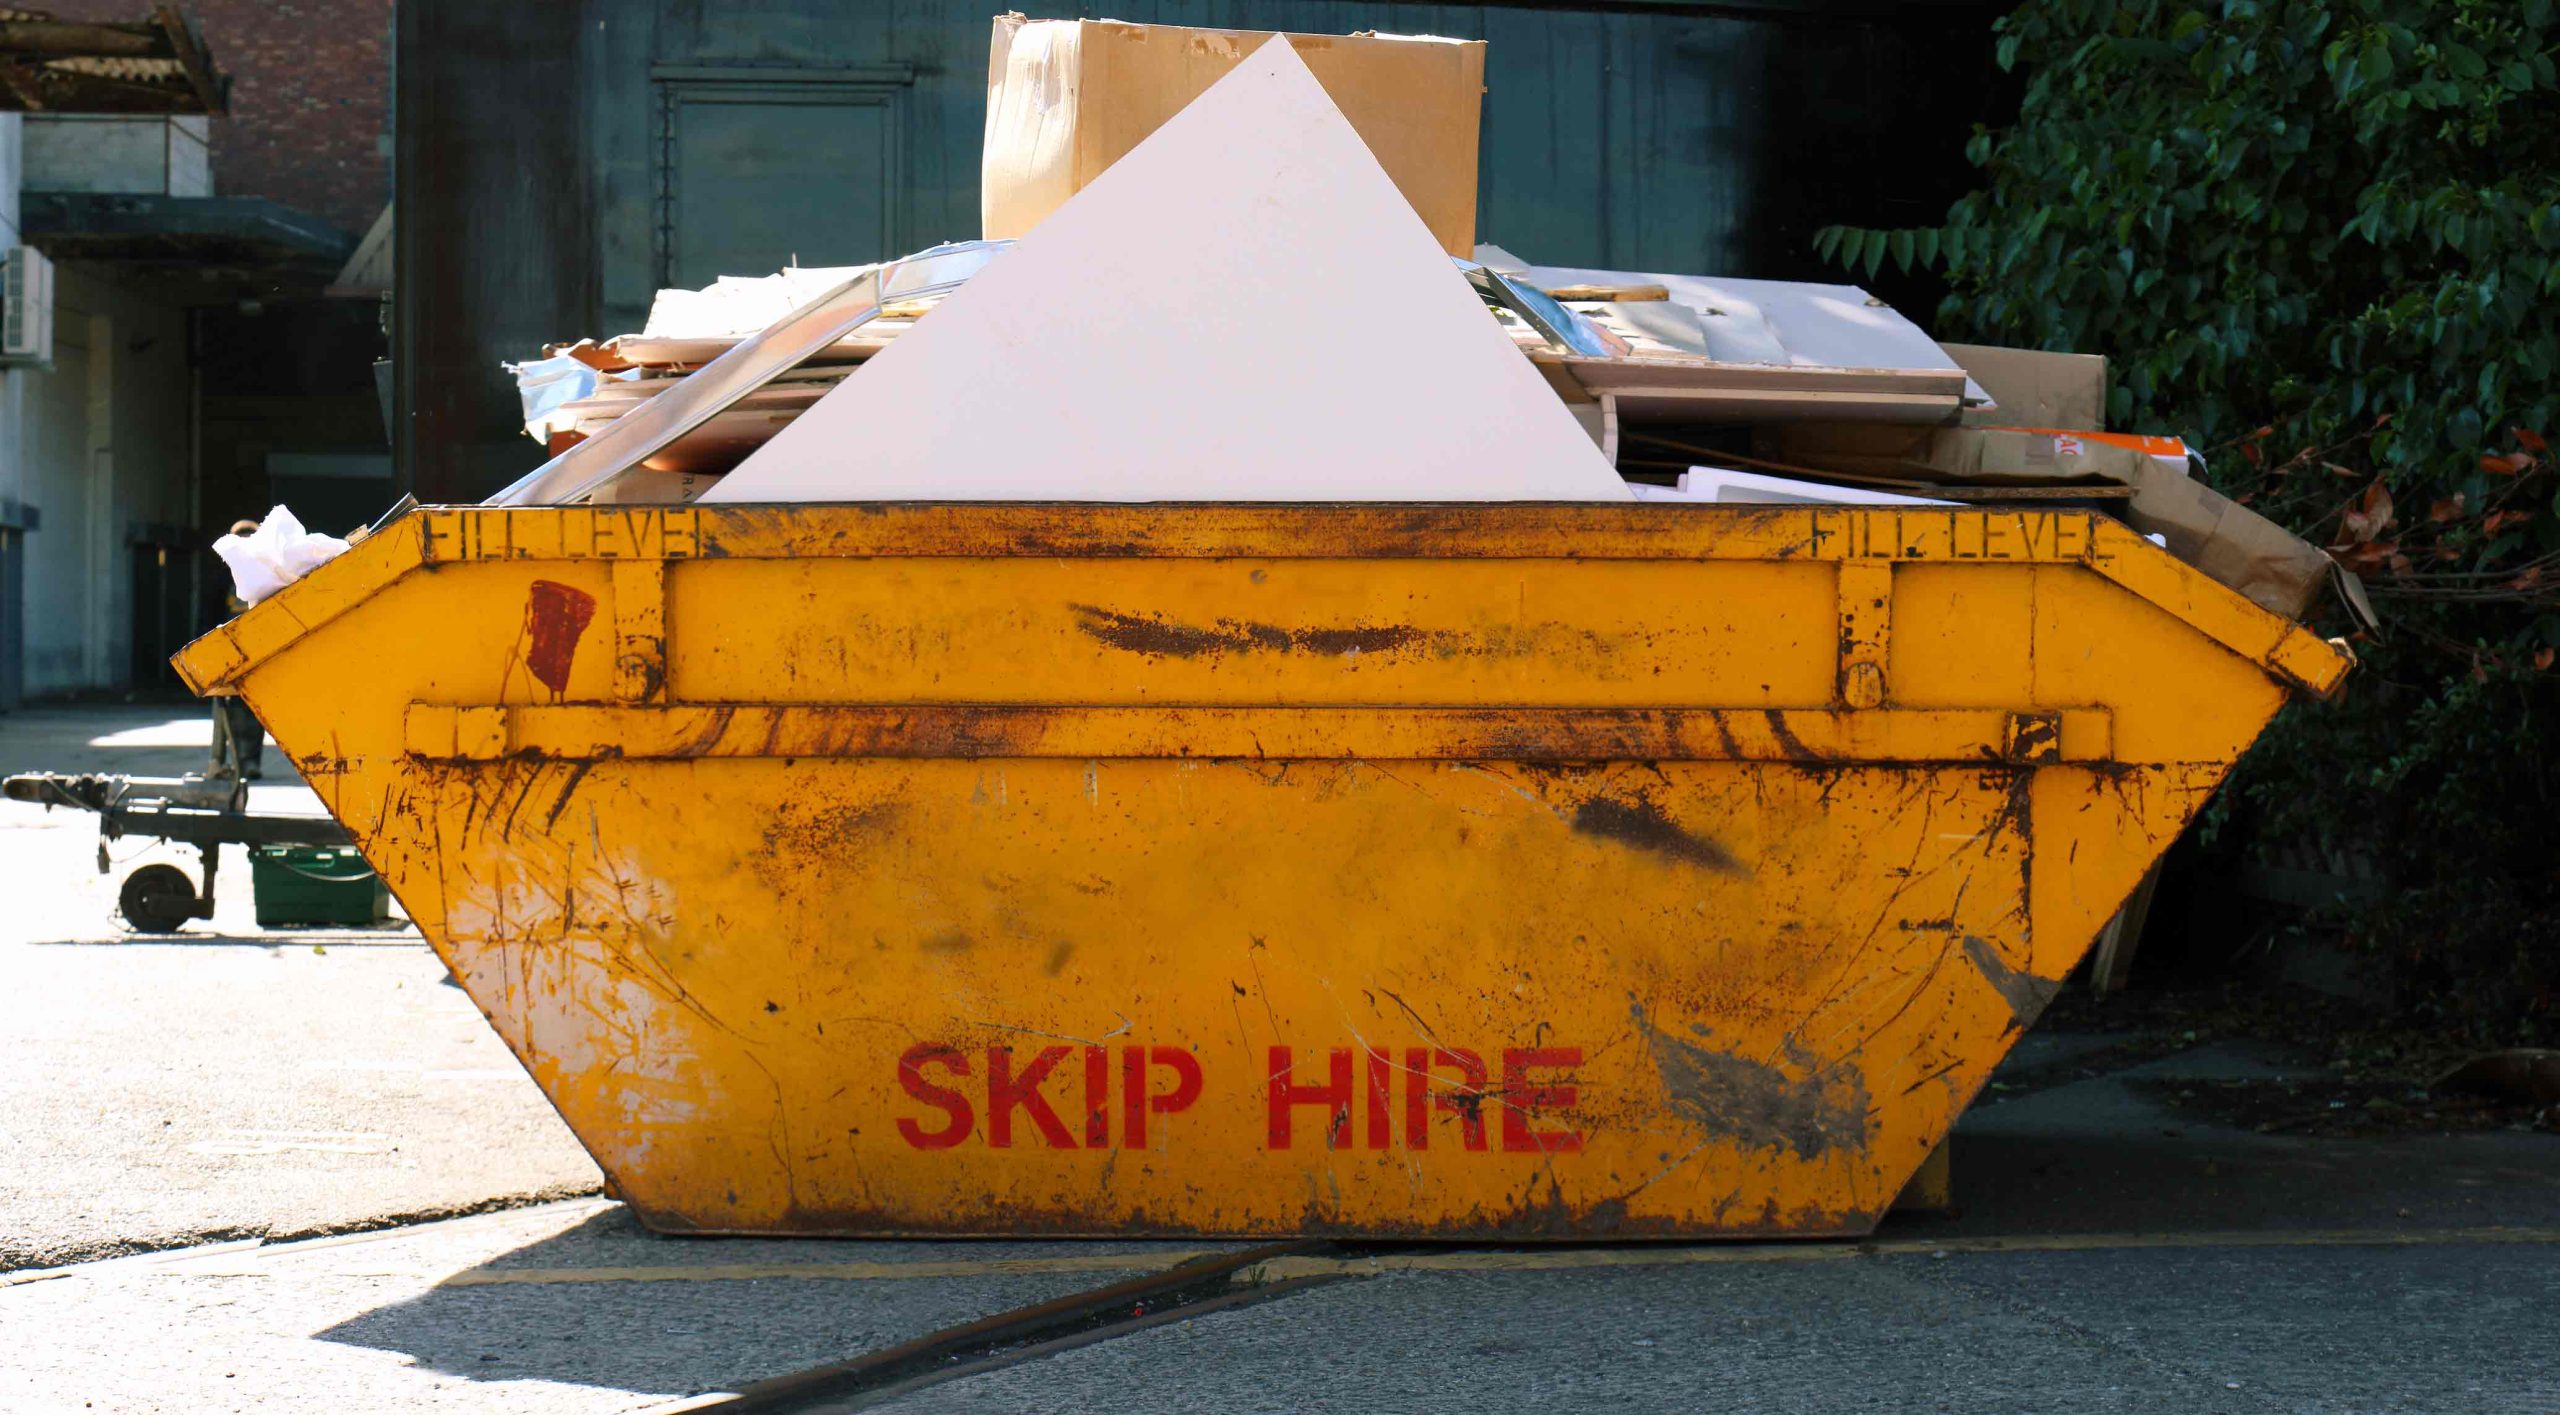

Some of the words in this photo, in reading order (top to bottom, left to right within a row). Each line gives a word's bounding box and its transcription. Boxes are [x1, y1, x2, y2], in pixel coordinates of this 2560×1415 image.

[422, 509, 534, 559] FILL
[560, 509, 728, 559] LEVEL
[1811, 509, 1925, 559] FILL
[1950, 510, 2116, 561] LEVEL
[896, 1041, 1204, 1151] SKIP
[1267, 1046, 1584, 1152] HIRE
